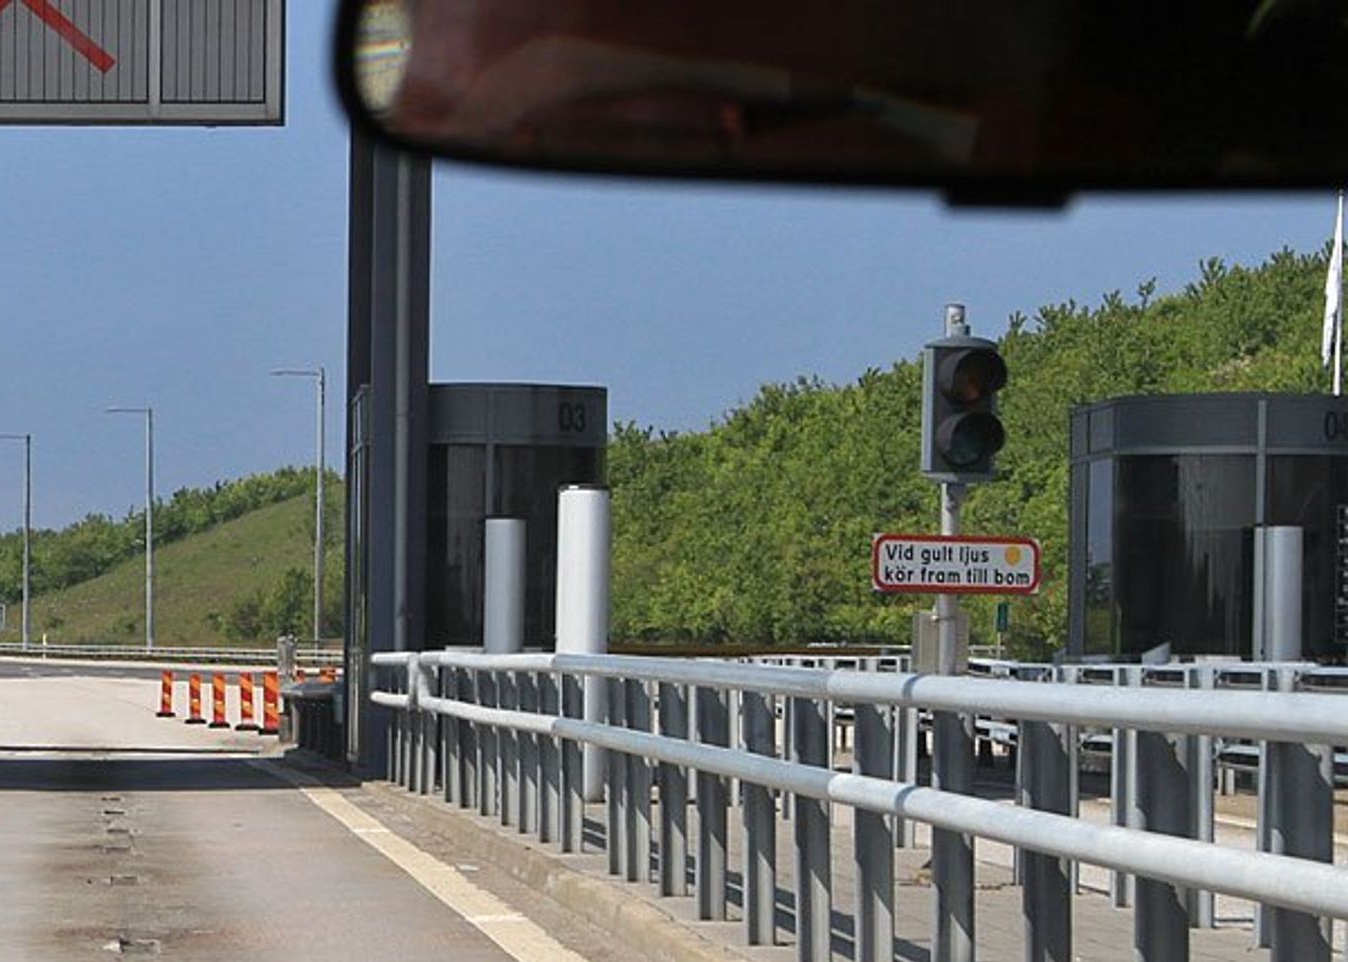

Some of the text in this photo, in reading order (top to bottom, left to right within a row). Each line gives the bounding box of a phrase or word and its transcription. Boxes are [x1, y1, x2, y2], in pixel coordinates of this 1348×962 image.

[557, 402, 588, 432] 03
[885, 544, 990, 565] Vid gult ljus
[884, 566, 1030, 585] kör fram till bom
